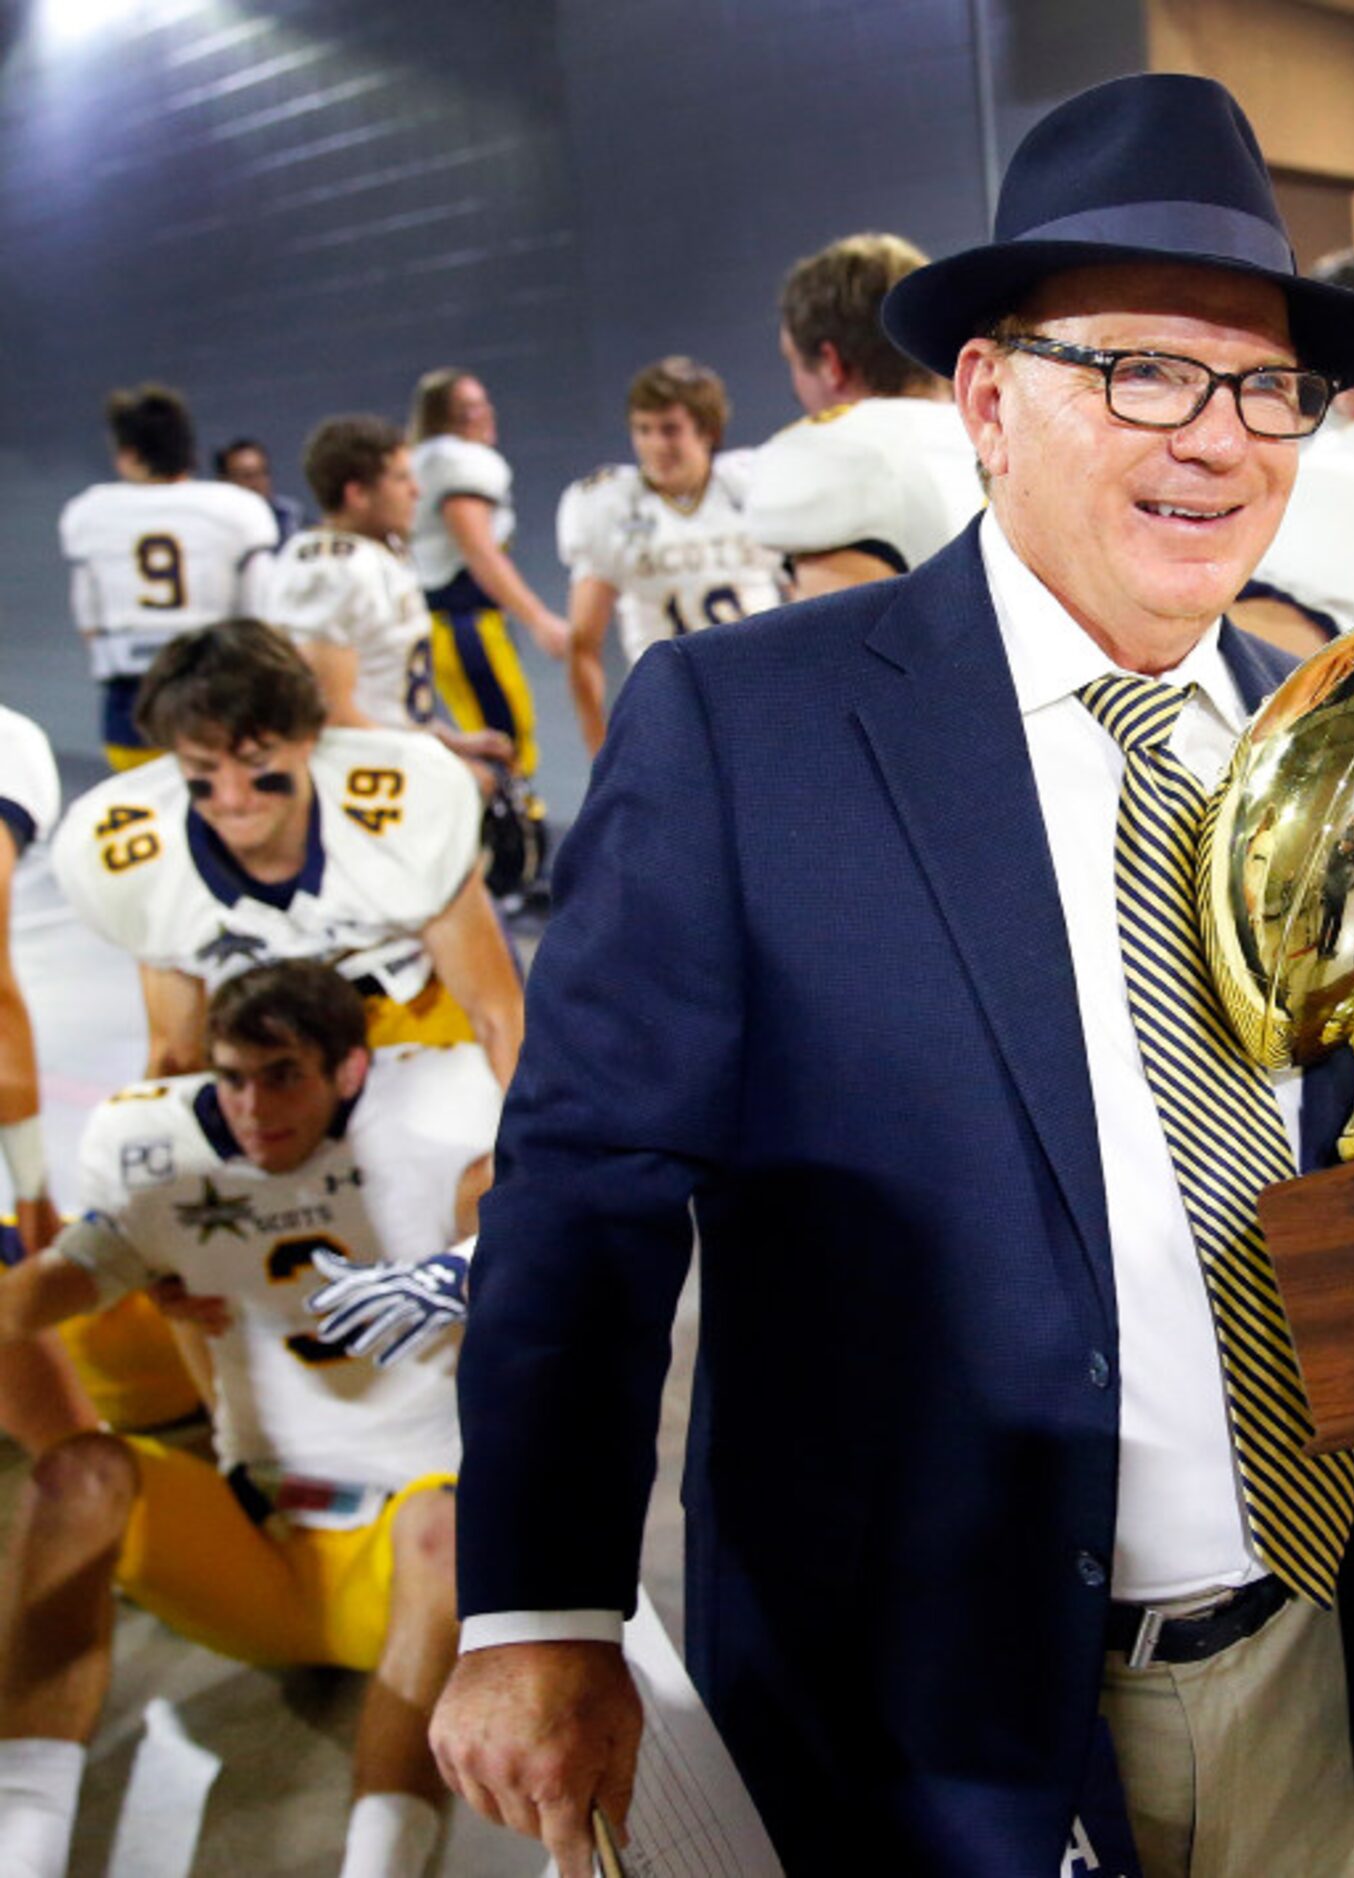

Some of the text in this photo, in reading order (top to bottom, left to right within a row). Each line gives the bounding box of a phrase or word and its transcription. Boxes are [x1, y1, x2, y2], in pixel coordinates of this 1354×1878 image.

[134, 530, 189, 610] 9
[342, 766, 405, 835] 49
[94, 804, 161, 874] 49
